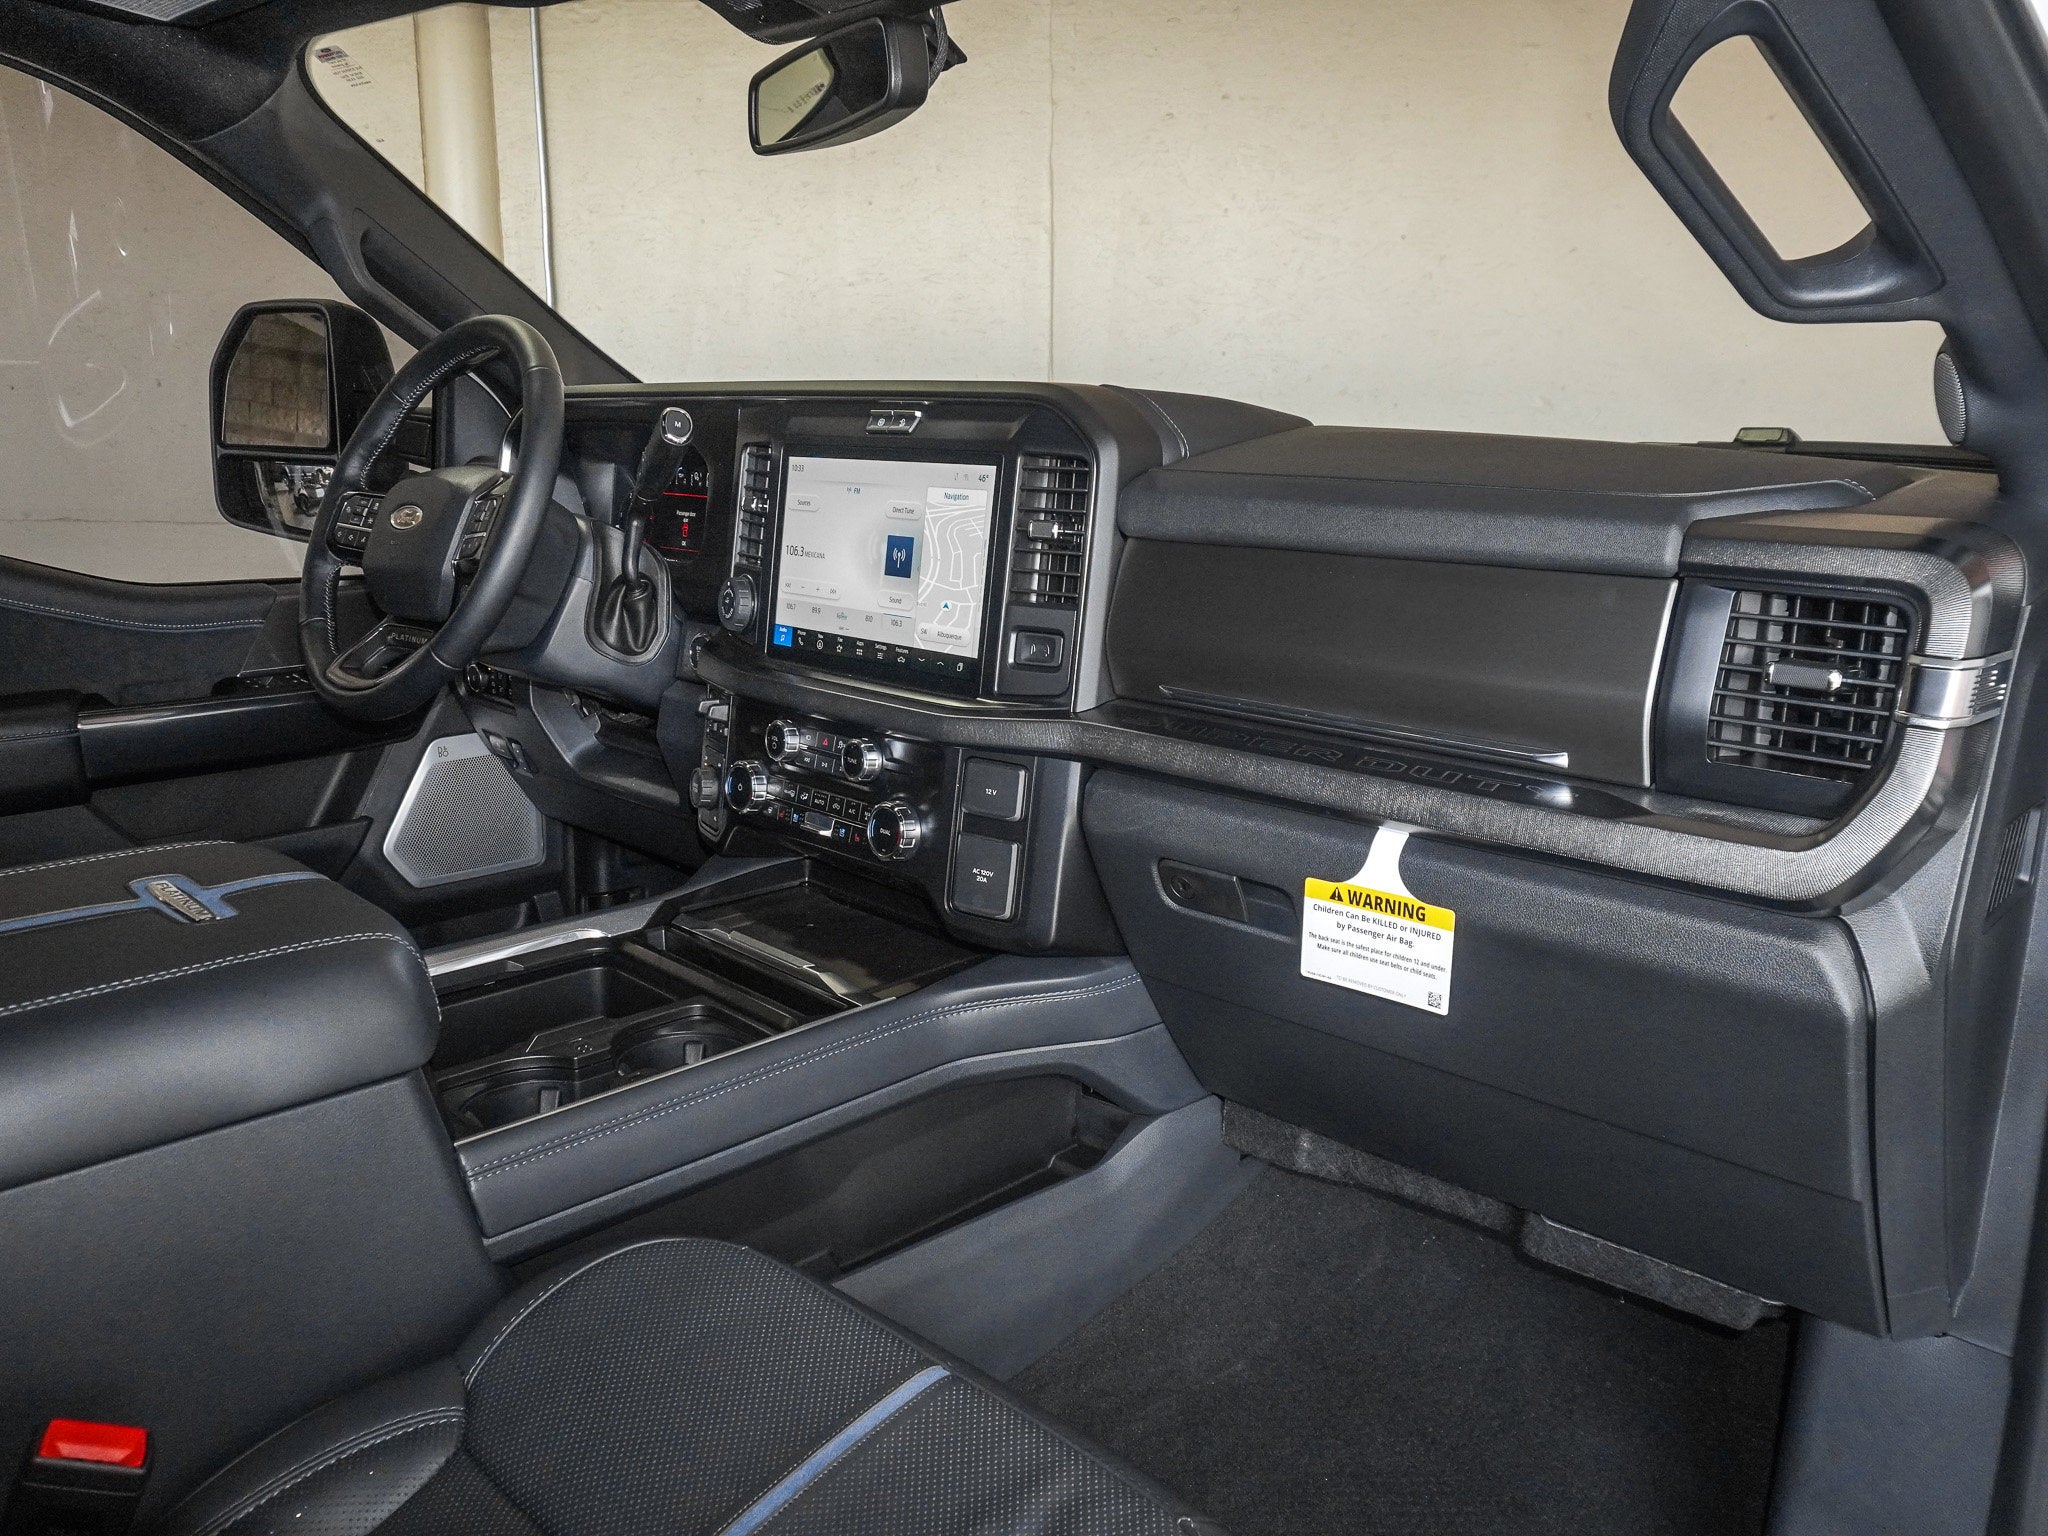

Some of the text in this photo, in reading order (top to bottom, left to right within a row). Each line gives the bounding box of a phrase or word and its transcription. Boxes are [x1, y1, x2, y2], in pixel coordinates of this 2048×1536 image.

[674, 420, 682, 428] M
[944, 492, 969, 501] Navigation
[786, 544, 805, 557] 106.3
[888, 596, 902, 604] Sound
[391, 632, 428, 645] PLATINUM
[937, 631, 962, 640] Albuquerque
[976, 875, 988, 883] 20A
[980, 869, 994, 877] 120V
[157, 882, 211, 918] PLATINUM
[1347, 889, 1426, 922] WARNING
[1313, 903, 1344, 917] Children
[1345, 911, 1360, 920] Can
[1361, 914, 1371, 923] Be
[1372, 917, 1398, 930] KILLED
[1410, 927, 1442, 941] INJURED
[1336, 921, 1415, 949] by Passenger Air Bag.
[1308, 931, 1318, 940] The
[1355, 943, 1370, 952] safest
[1370, 948, 1383, 956] place
[1392, 954, 1413, 963] children
[1413, 958, 1420, 966] 12
[1420, 961, 1430, 969] and
[1317, 942, 1330, 952] Make
[1349, 951, 1369, 961] children
[1369, 956, 1379, 964] use
[1379, 959, 1390, 967] seat
[1390, 961, 1403, 970] belts
[1409, 967, 1422, 976] child
